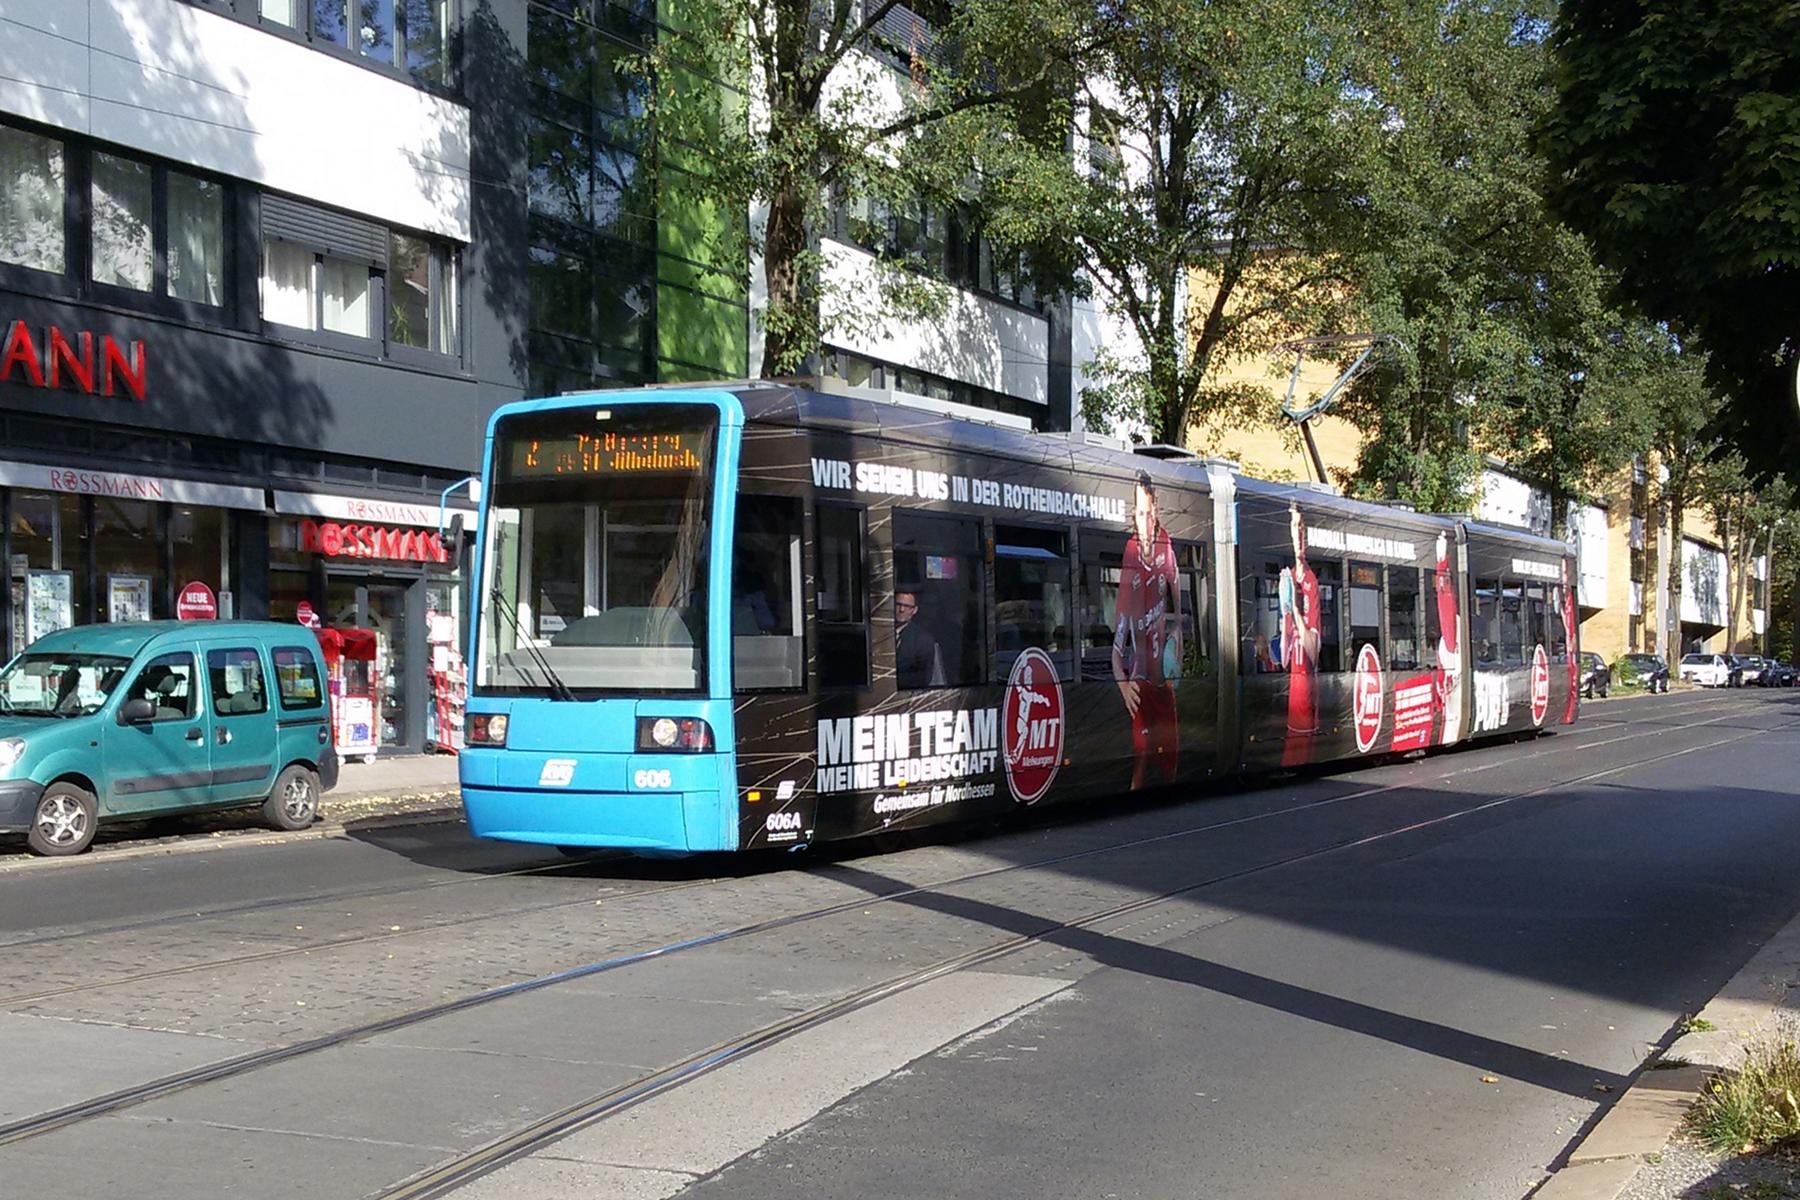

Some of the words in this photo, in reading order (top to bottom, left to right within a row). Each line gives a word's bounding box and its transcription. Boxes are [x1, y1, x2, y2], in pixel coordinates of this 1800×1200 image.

[0, 318, 147, 401] ANN
[50, 469, 162, 497] ROSSMANN
[811, 458, 851, 489] WIR
[856, 462, 913, 496] SEHEN
[916, 470, 949, 500] UNS
[952, 475, 968, 502] IN
[972, 478, 1000, 506] DER
[1003, 483, 1126, 522] ROTHENBACH-HALLE
[347, 500, 430, 523] ROSSMANN
[302, 519, 448, 563] ROSSMAN
[185, 592, 208, 604] NEUE
[817, 713, 910, 766] MEIN
[915, 708, 997, 756] TEAM
[1029, 718, 1060, 750] MT
[634, 769, 672, 788] 606
[817, 761, 880, 793] MEINE
[884, 750, 997, 786] LEIDENSCHAFT
[873, 791, 928, 814] Gemeinsam
[930, 785, 945, 806] für
[945, 782, 995, 803] Nordhessen
[766, 811, 802, 831] 606A
